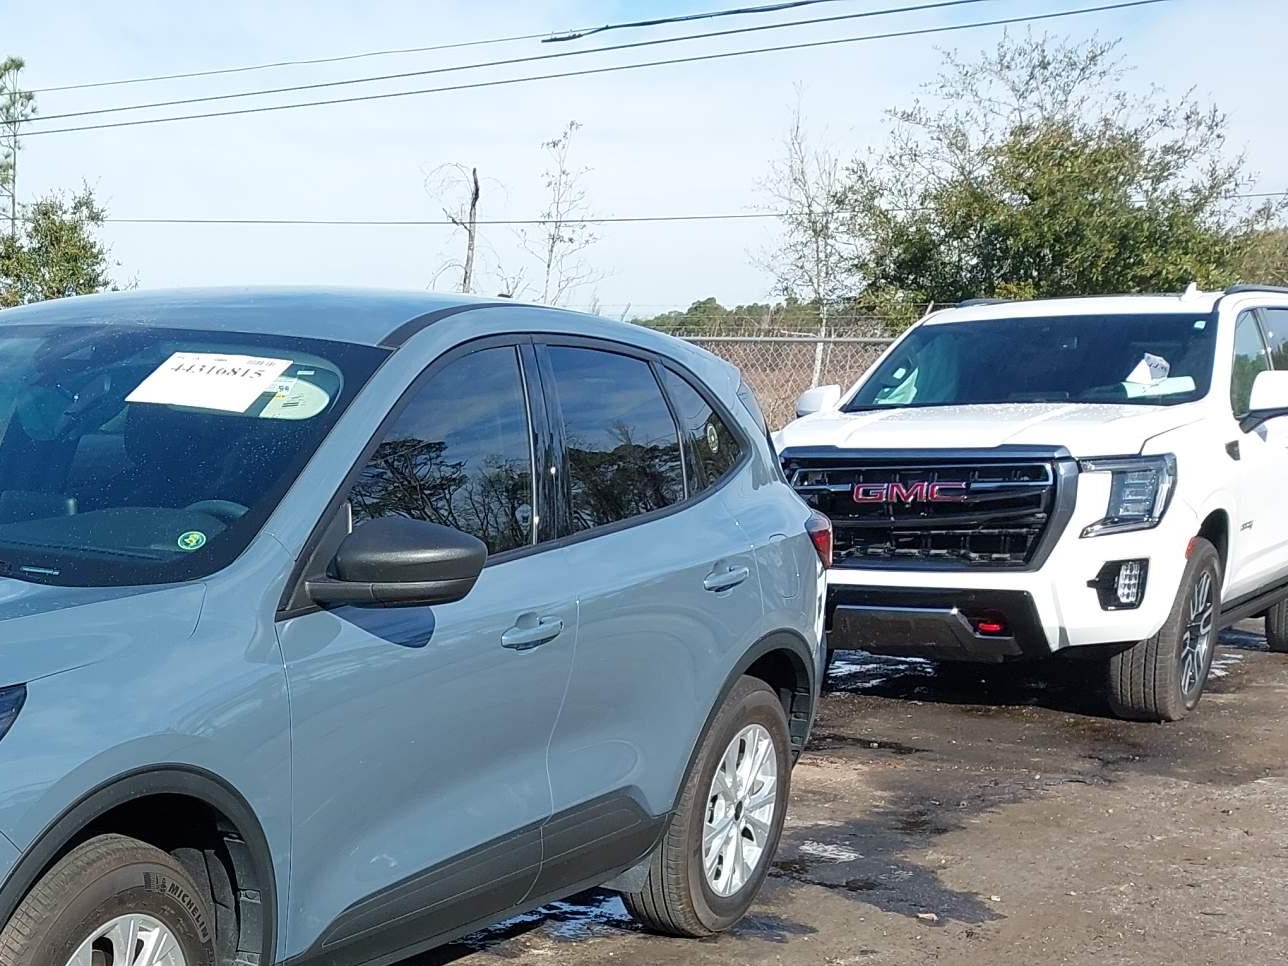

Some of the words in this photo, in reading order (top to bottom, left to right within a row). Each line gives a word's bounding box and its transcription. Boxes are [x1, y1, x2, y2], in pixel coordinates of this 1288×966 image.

[171, 363, 264, 379] 44316815
[853, 481, 967, 503] GMC
[168, 883, 209, 938] MICHELIN
